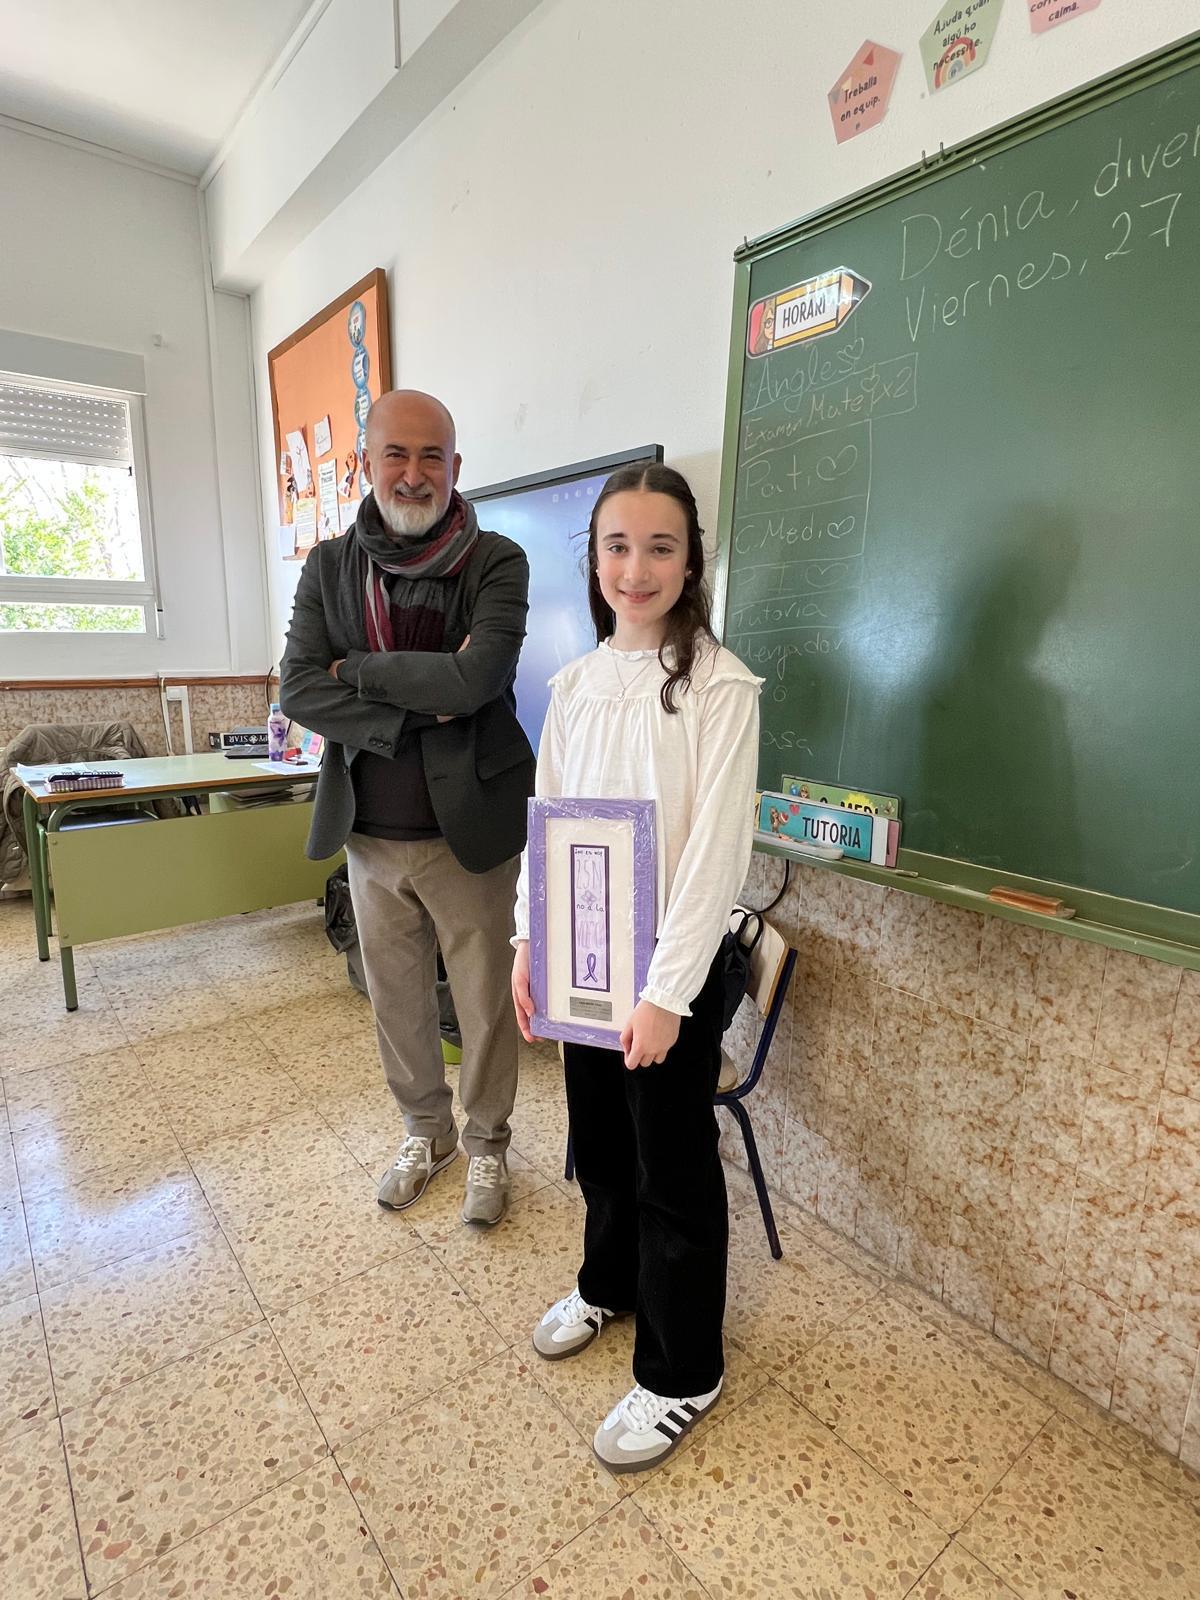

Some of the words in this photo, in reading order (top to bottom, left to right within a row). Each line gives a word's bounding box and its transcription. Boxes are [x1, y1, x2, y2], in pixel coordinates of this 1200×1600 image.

[933, 9, 963, 36] Ajuda
[1048, 2, 1080, 21] calma.
[943, 27, 962, 48] algú
[964, 22, 977, 35] ho
[840, 109, 851, 121] en
[853, 95, 881, 116] equip.
[905, 252, 1088, 342] Viernes,
[1104, 193, 1182, 260] 27
[782, 294, 826, 328] HORARI
[228, 735, 249, 743] STAR
[802, 817, 861, 849] TUTORIA
